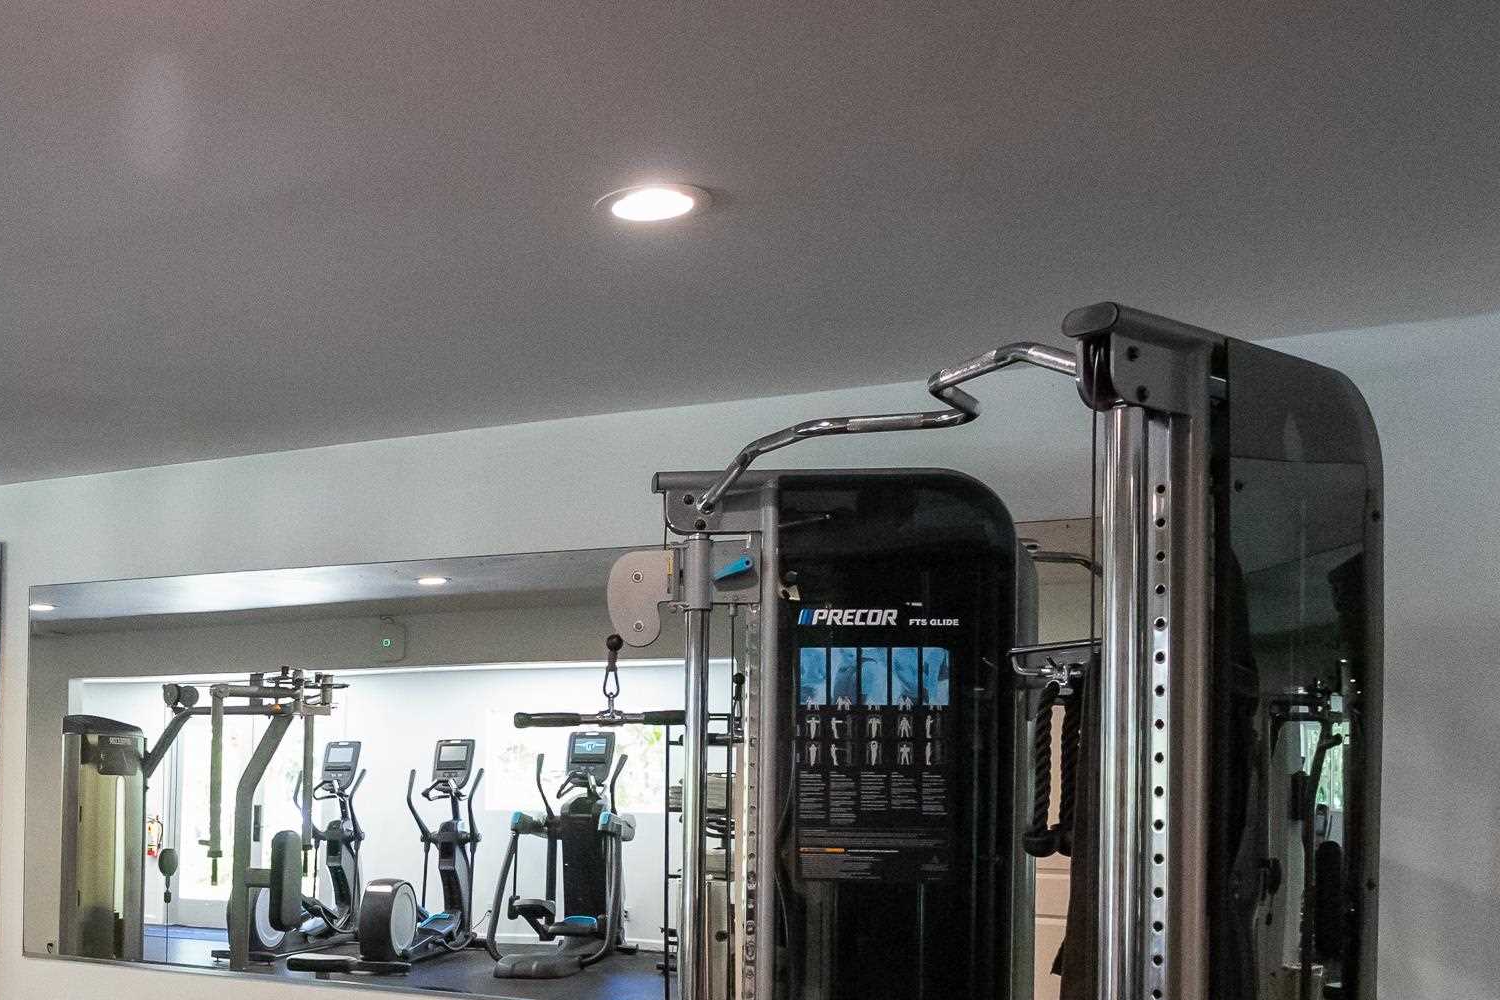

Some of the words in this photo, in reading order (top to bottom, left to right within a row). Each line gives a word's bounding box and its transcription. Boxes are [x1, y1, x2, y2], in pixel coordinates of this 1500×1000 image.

[811, 608, 898, 626] PRECOR
[909, 618, 928, 626] FTS
[929, 618, 960, 626] GLIDE
